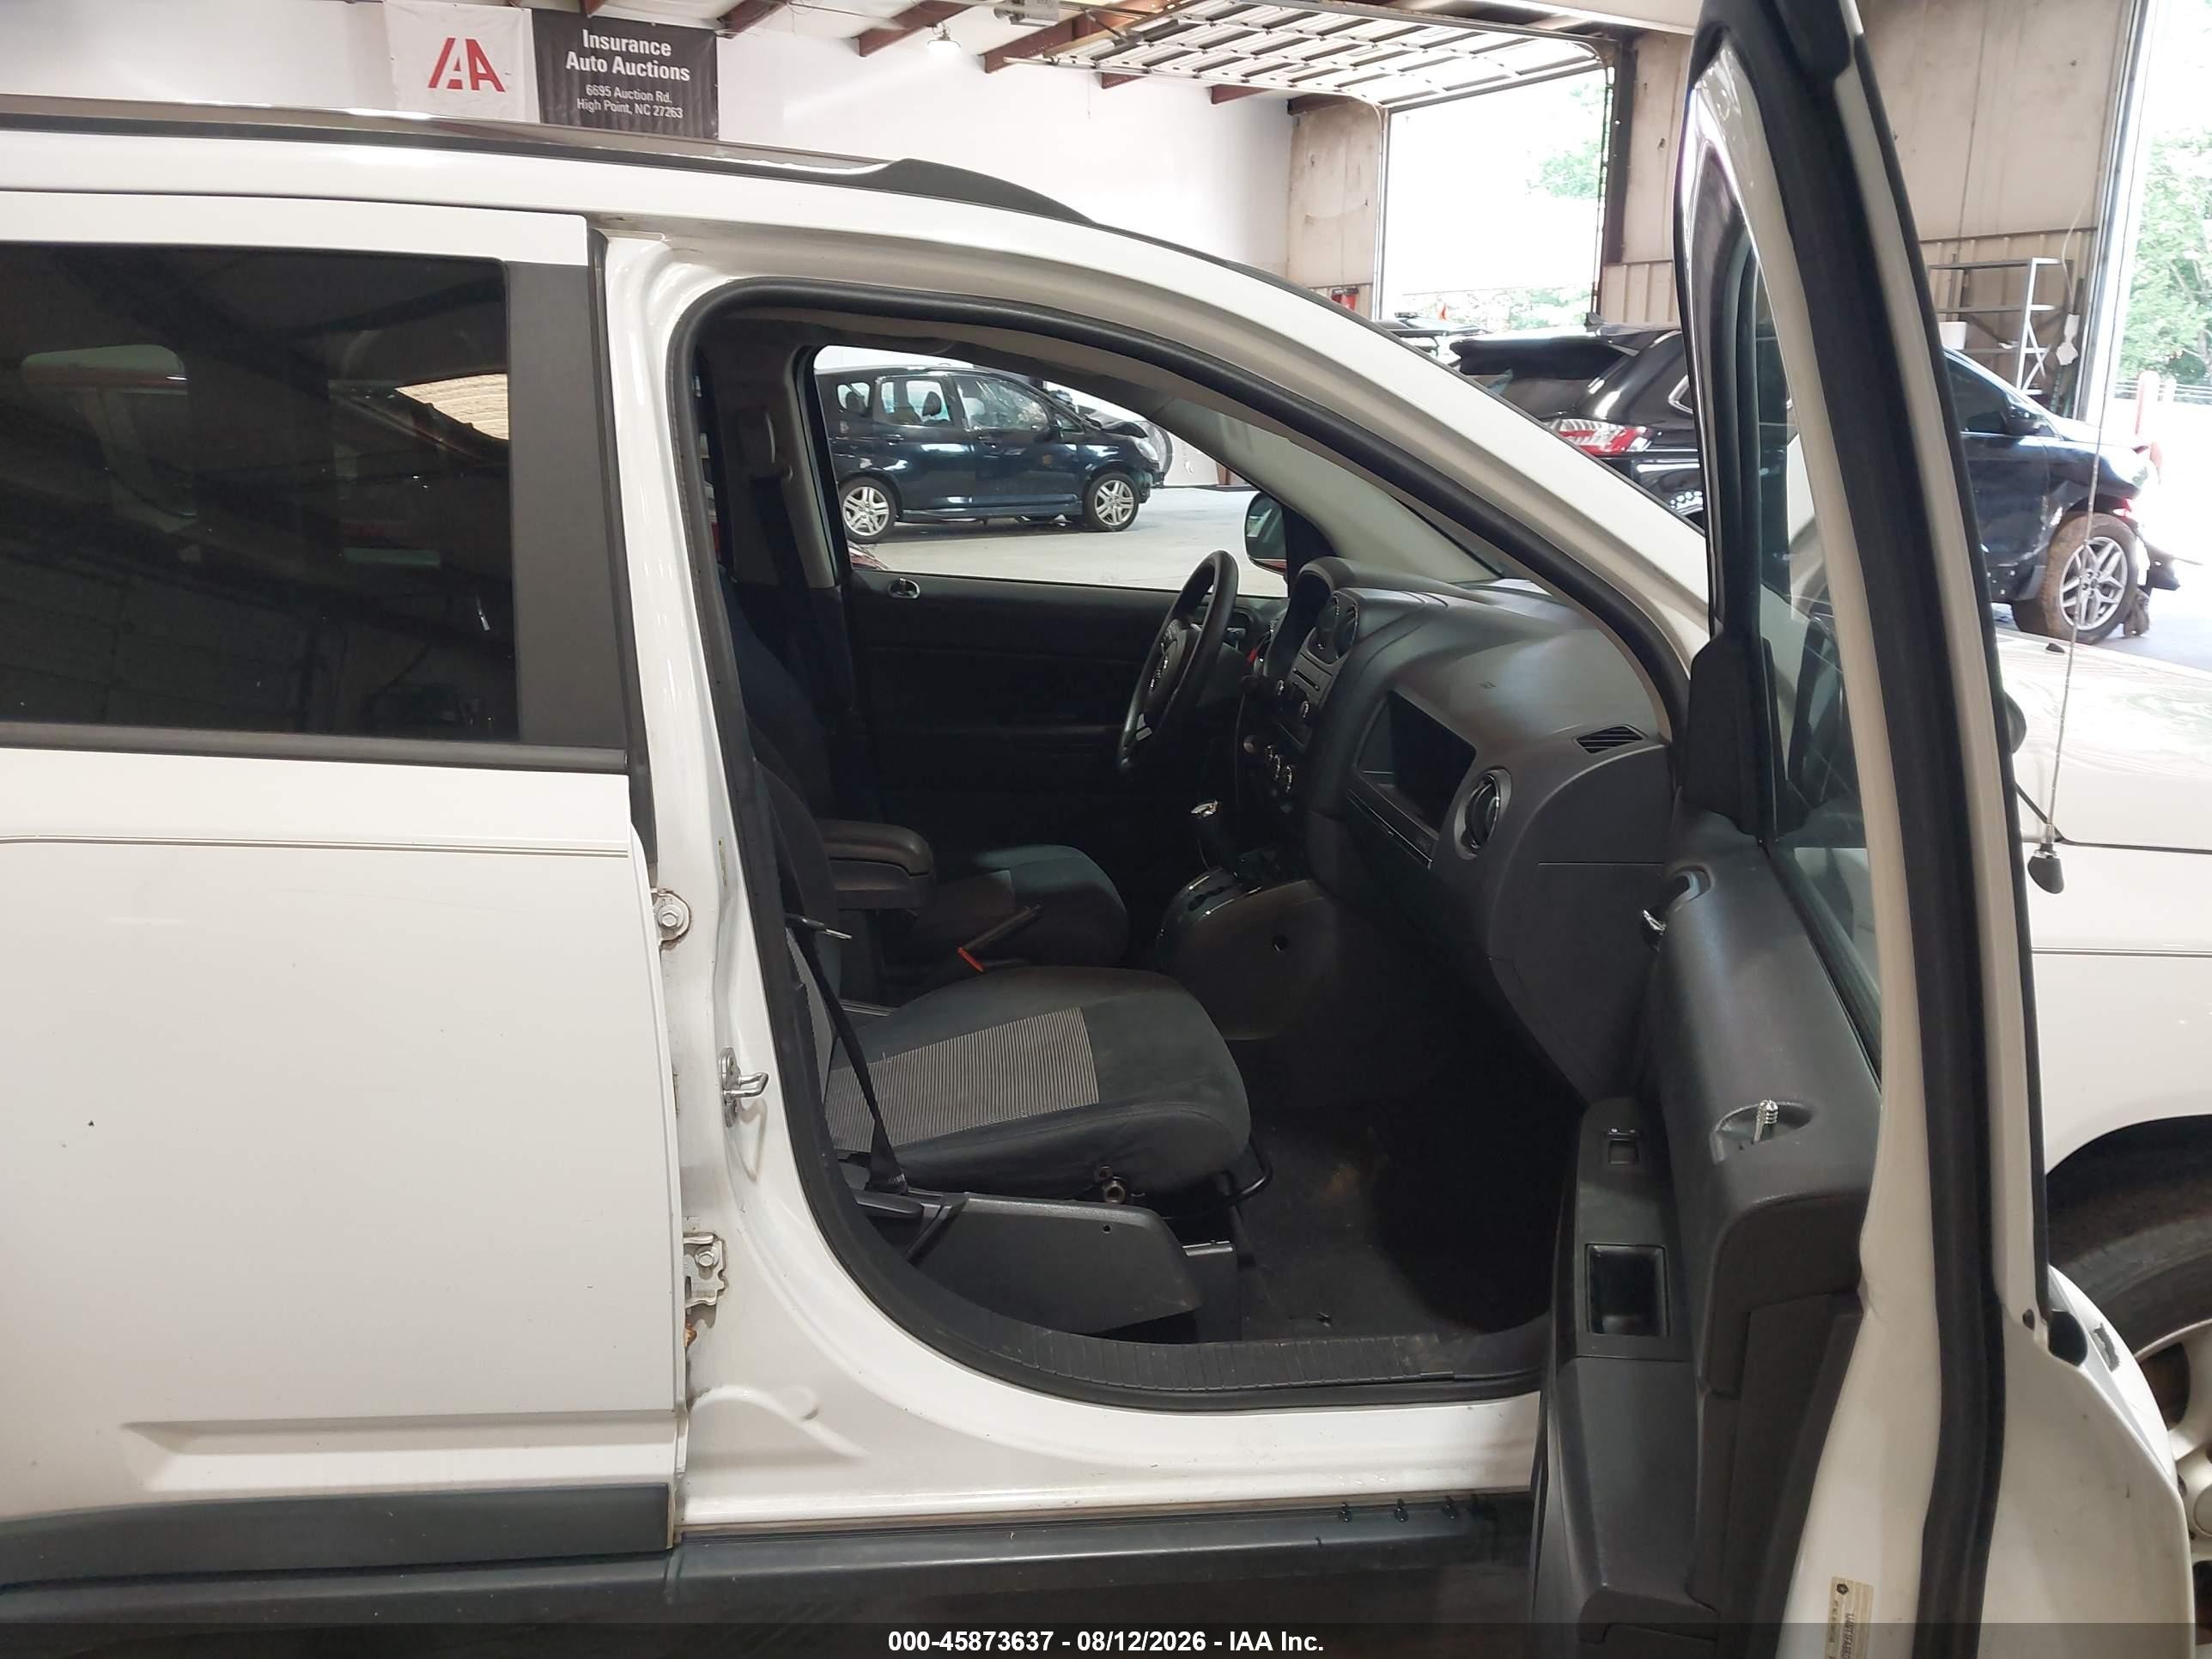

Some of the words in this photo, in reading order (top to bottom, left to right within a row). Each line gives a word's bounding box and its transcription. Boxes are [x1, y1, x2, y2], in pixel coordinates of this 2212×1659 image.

[582, 29, 672, 57] Insurance
[566, 51, 608, 73] Auto
[611, 56, 690, 82] Auctions
[586, 84, 611, 97] 6695
[614, 87, 653, 101] Auction
[655, 90, 672, 103] Rd.
[576, 98, 601, 112] High
[603, 100, 632, 114] Point,
[635, 103, 651, 115] NC
[653, 105, 684, 118] 27263
